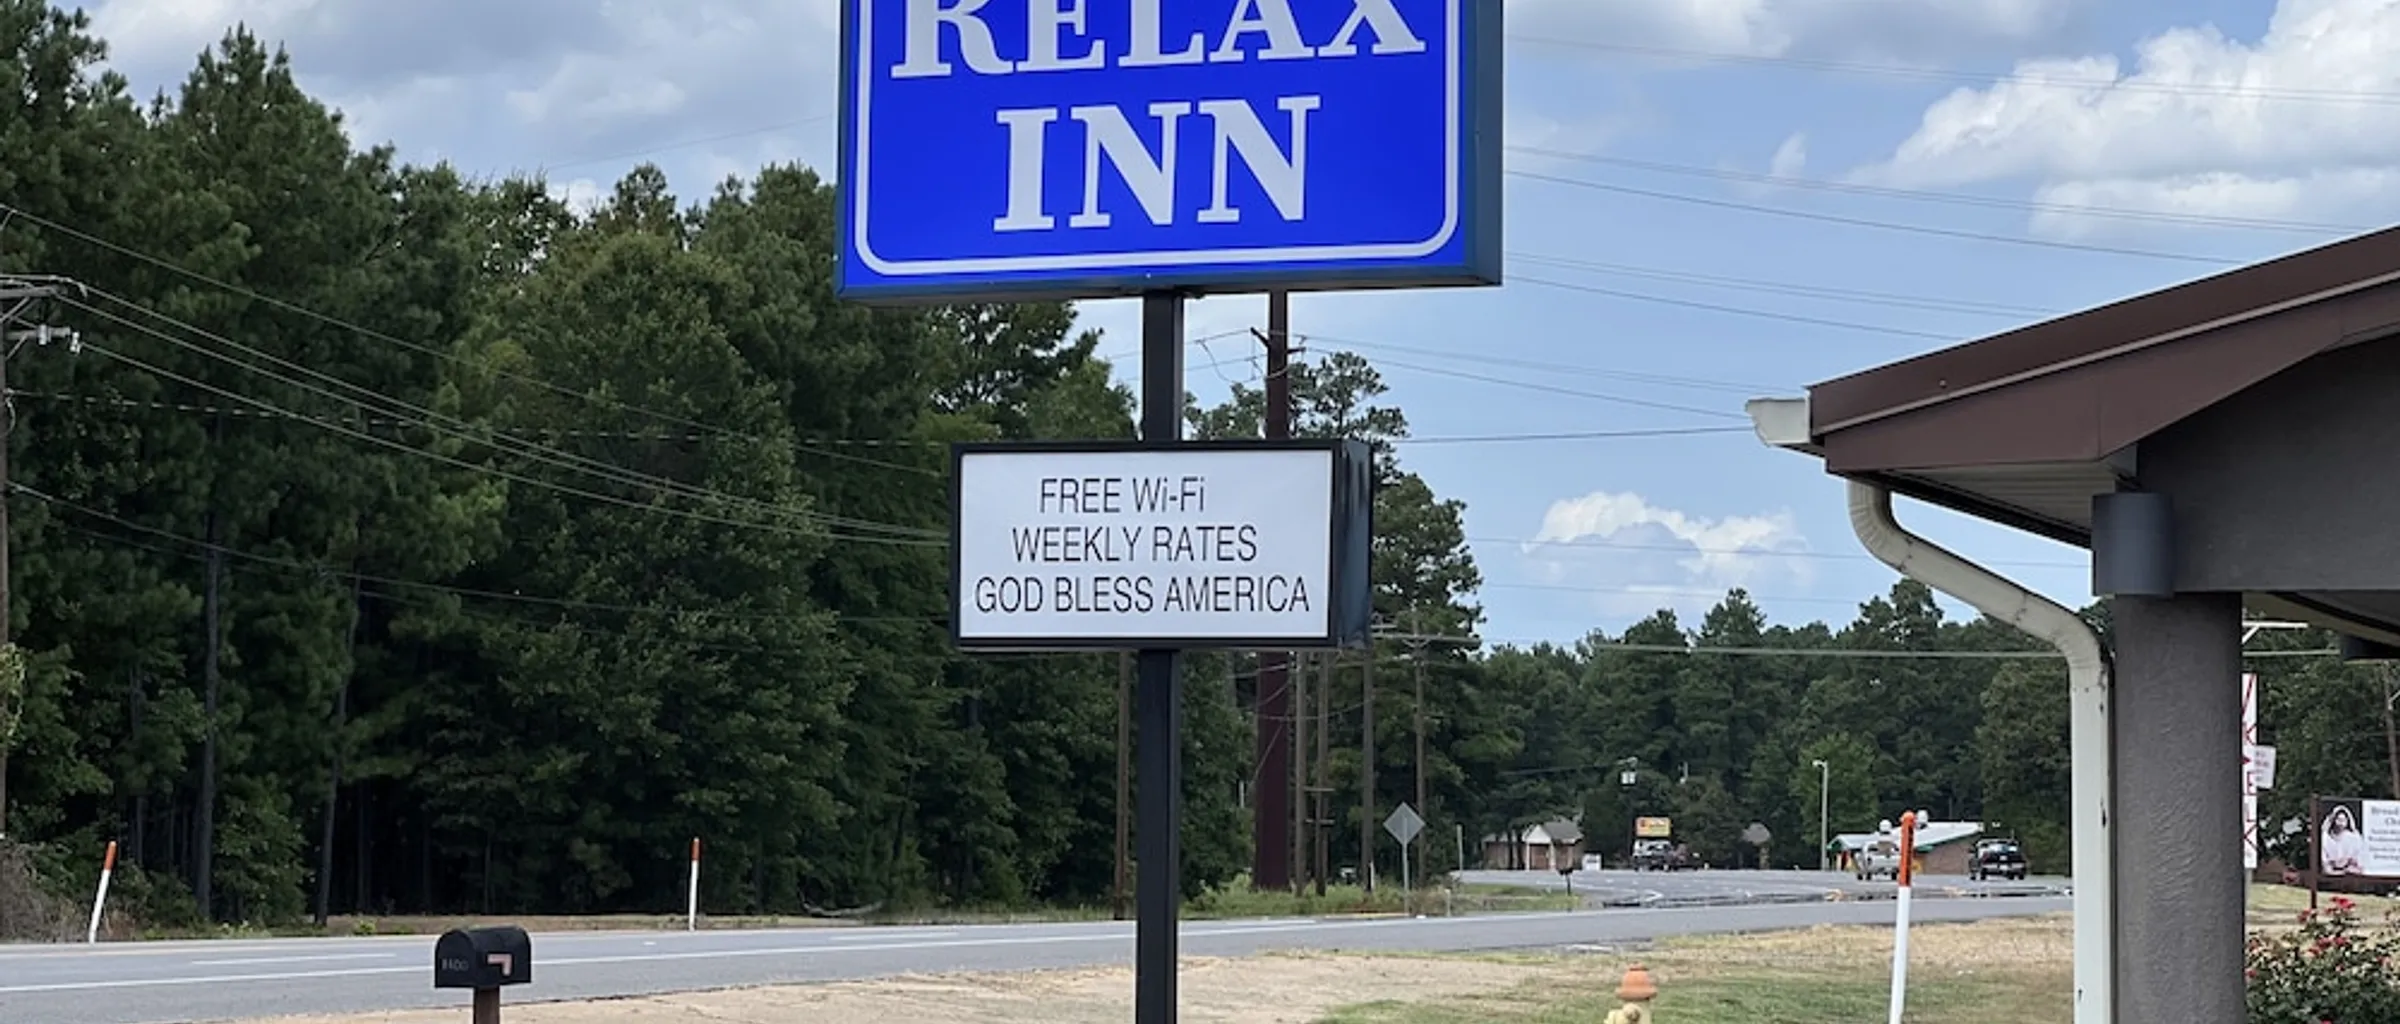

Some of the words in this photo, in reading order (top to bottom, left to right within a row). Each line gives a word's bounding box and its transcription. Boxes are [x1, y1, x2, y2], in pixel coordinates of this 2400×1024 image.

[994, 96, 1320, 230] INN
[1041, 478, 1122, 513] FREE
[1133, 477, 1204, 512] Wi-Fi
[1013, 526, 1141, 562] WEEKLY
[1153, 525, 1256, 561] RATES
[976, 577, 1043, 613] GOD
[1056, 576, 1153, 613] BLESS
[1164, 575, 1309, 612] AMERICA
